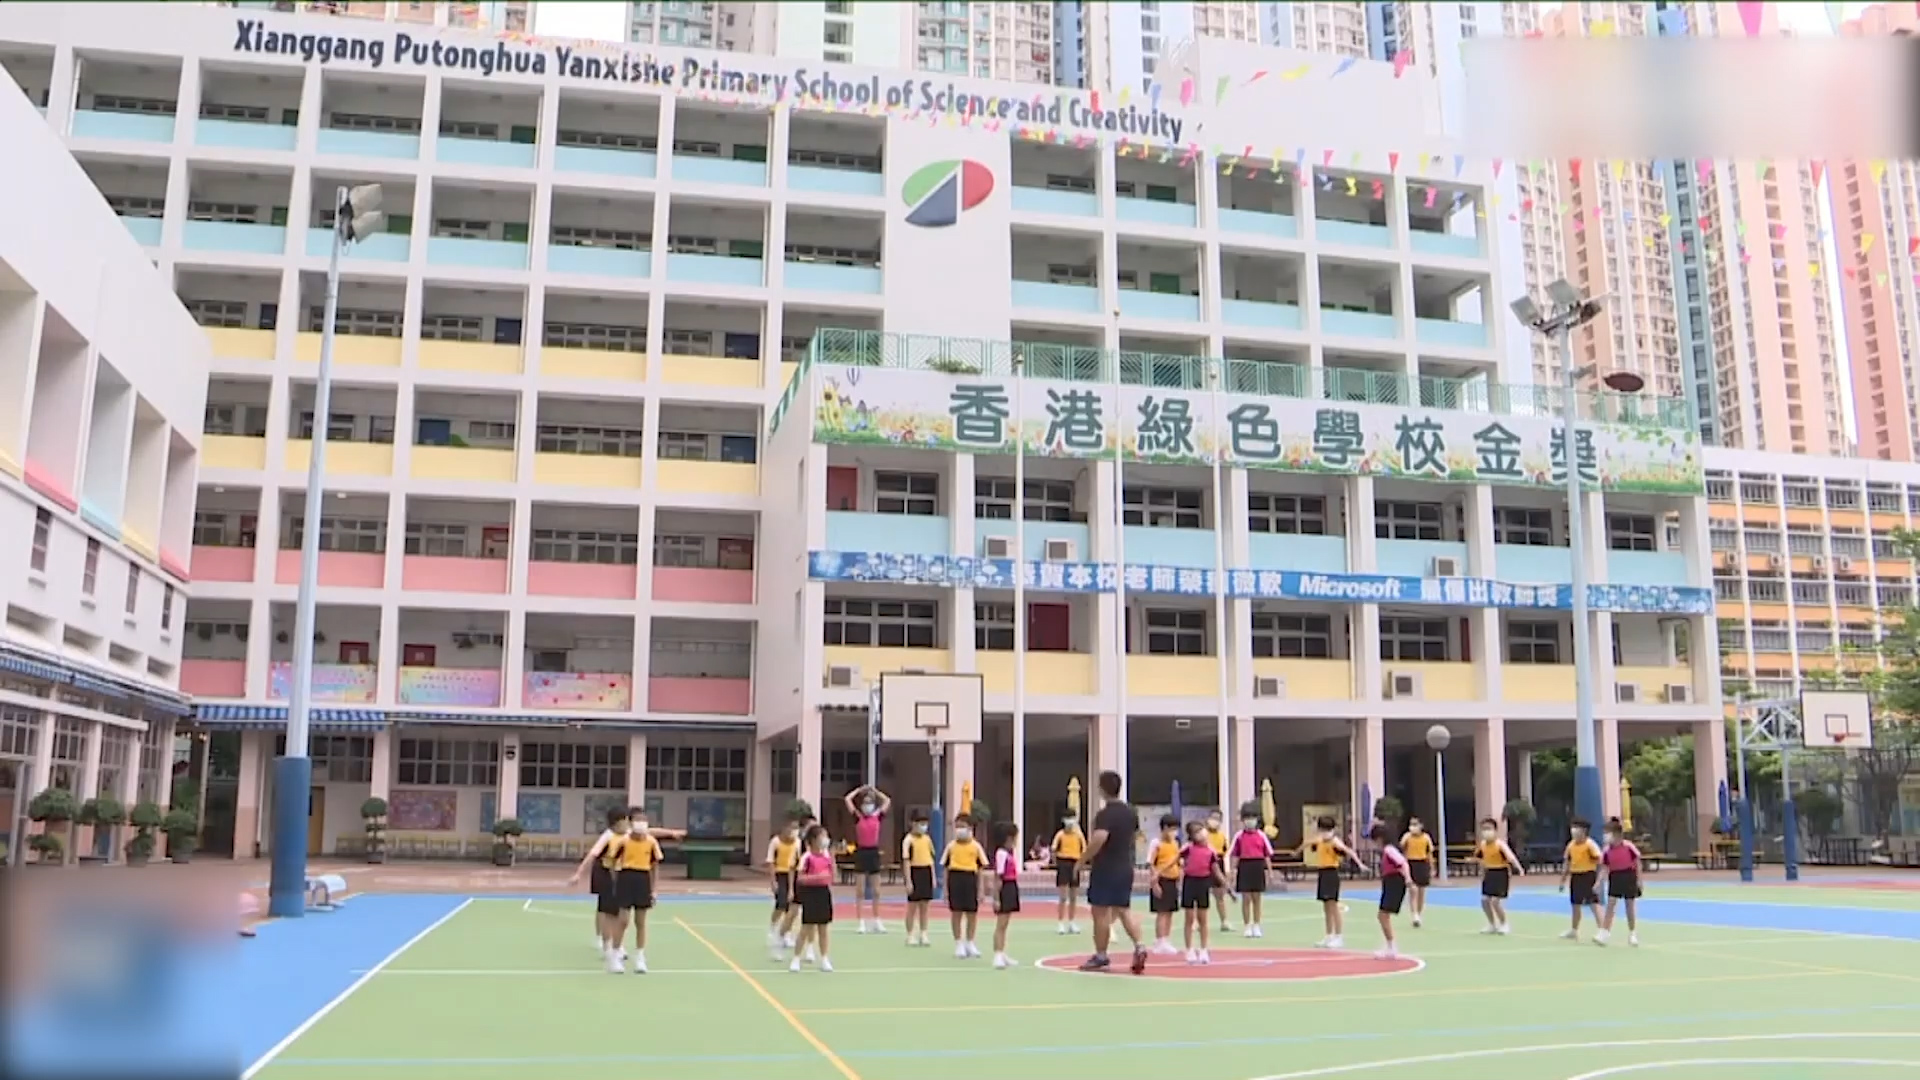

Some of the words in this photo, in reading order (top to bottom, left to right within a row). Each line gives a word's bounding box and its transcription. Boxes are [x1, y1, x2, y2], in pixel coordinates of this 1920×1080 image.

[233, 19, 385, 68] Xianggang
[393, 34, 546, 77] Putonghua
[556, 46, 675, 85] Yanxishe
[681, 56, 789, 101] Primary
[794, 68, 879, 105] School
[885, 79, 914, 108] of
[919, 79, 1008, 119] Science
[1015, 97, 1061, 124] and
[1068, 99, 1183, 143] Creativity
[1299, 574, 1400, 599] Microsoft
